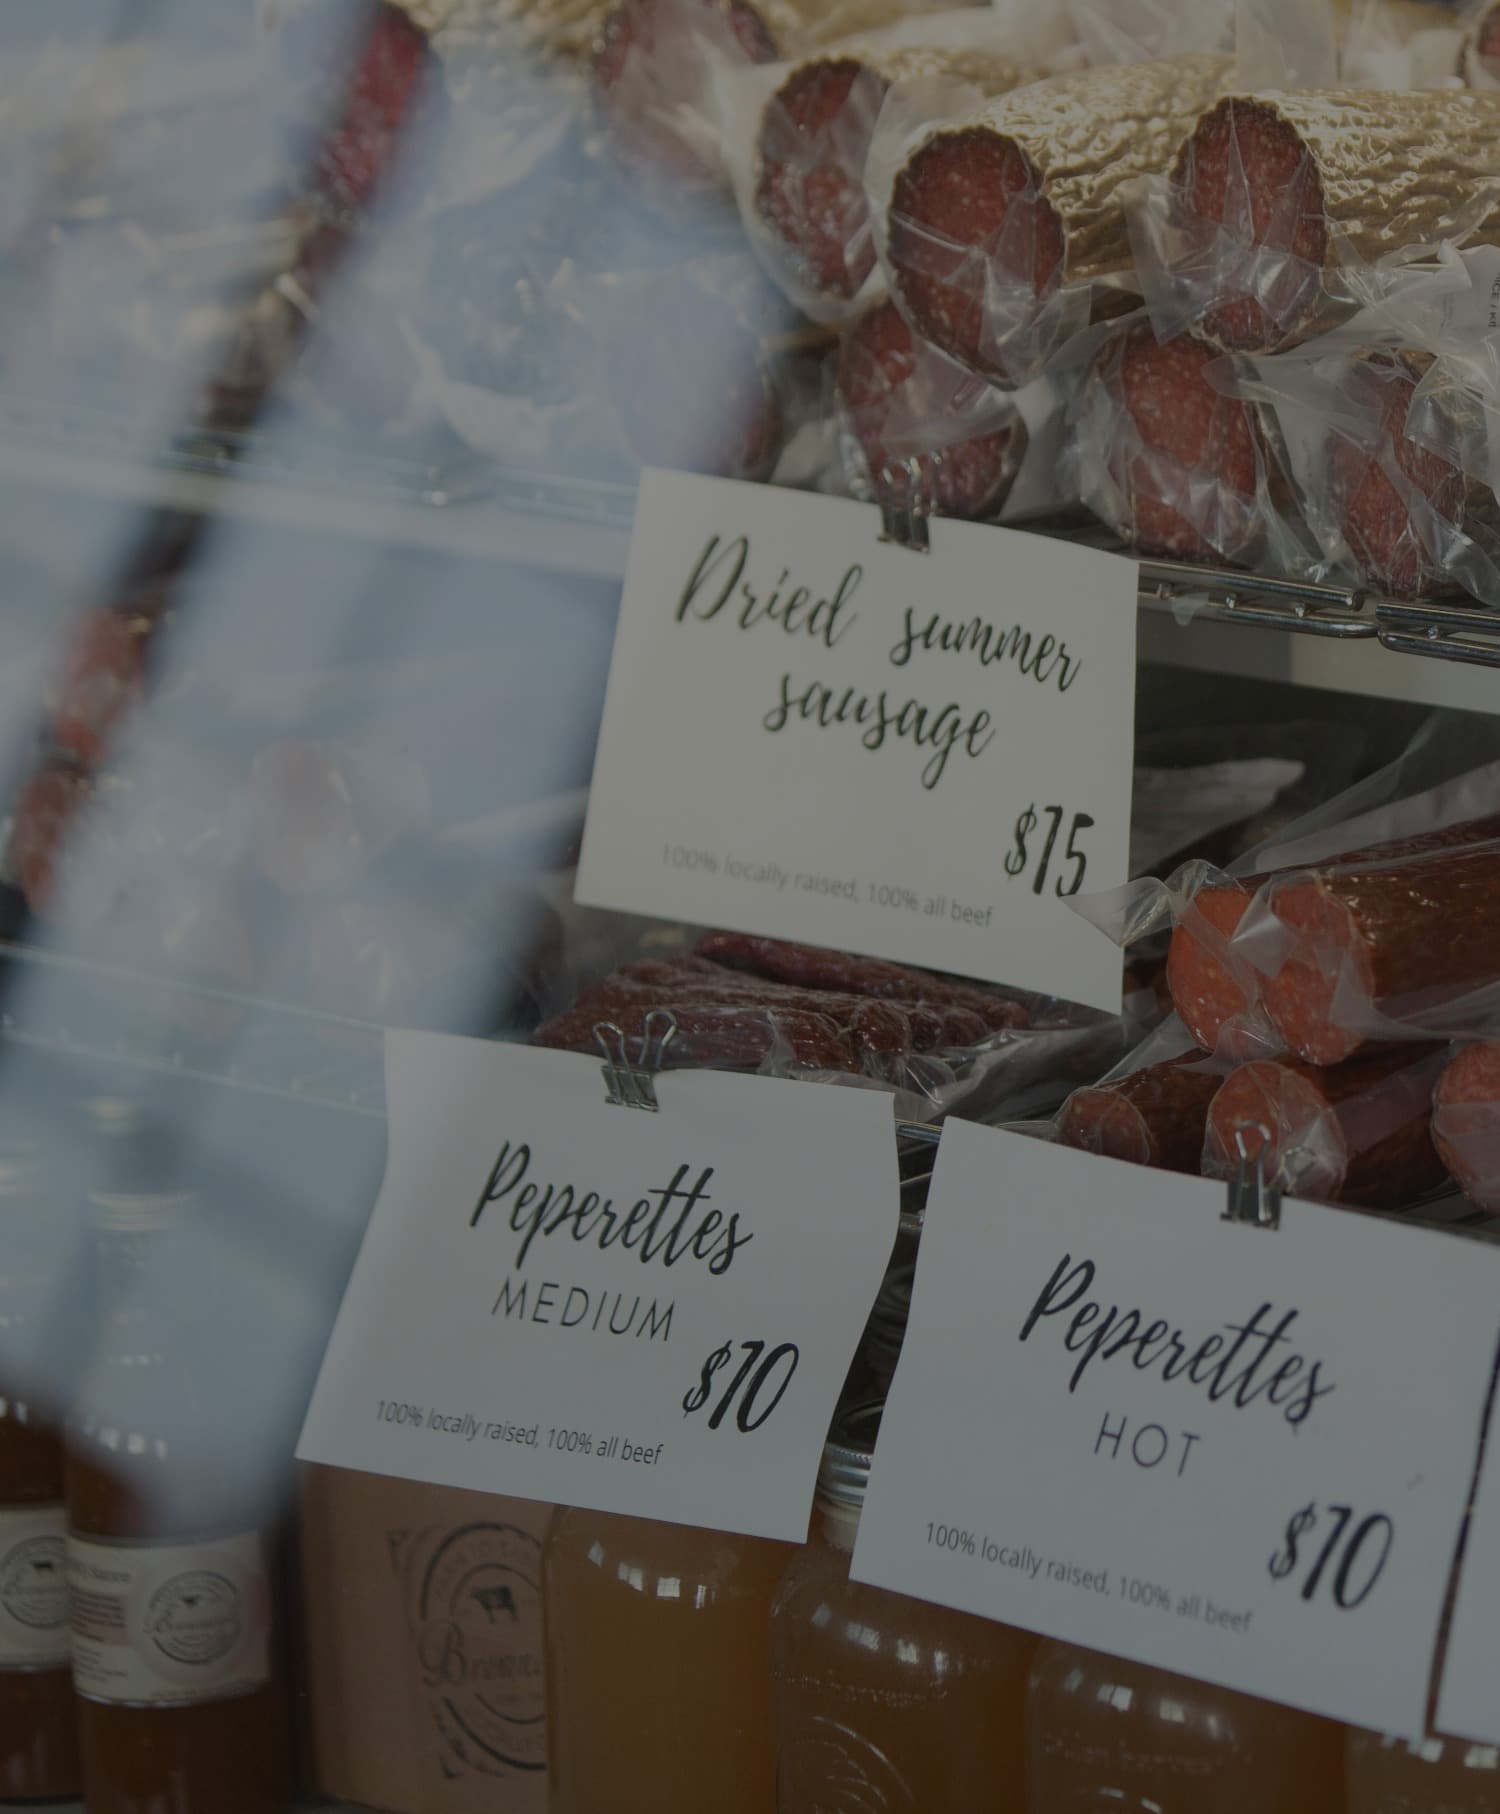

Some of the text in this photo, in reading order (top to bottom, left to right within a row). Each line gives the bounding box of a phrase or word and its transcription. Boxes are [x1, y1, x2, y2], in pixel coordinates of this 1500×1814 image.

[675, 534, 1082, 693] Dried summer
[763, 673, 996, 790] sausage
[661, 843, 995, 930] 100% locally raised, 100% all beef
[470, 1139, 755, 1275] Peperettes
[491, 1276, 676, 1342] MEDIUM
[1019, 1253, 1336, 1425] Peperettes
[375, 1399, 665, 1466] 100% locally raised, 100% all beef
[682, 1339, 800, 1433] $10
[1094, 1411, 1201, 1477] HOT
[925, 1521, 1254, 1634] 100% locally raised, 100% all beef
[1268, 1502, 1395, 1612] $10
